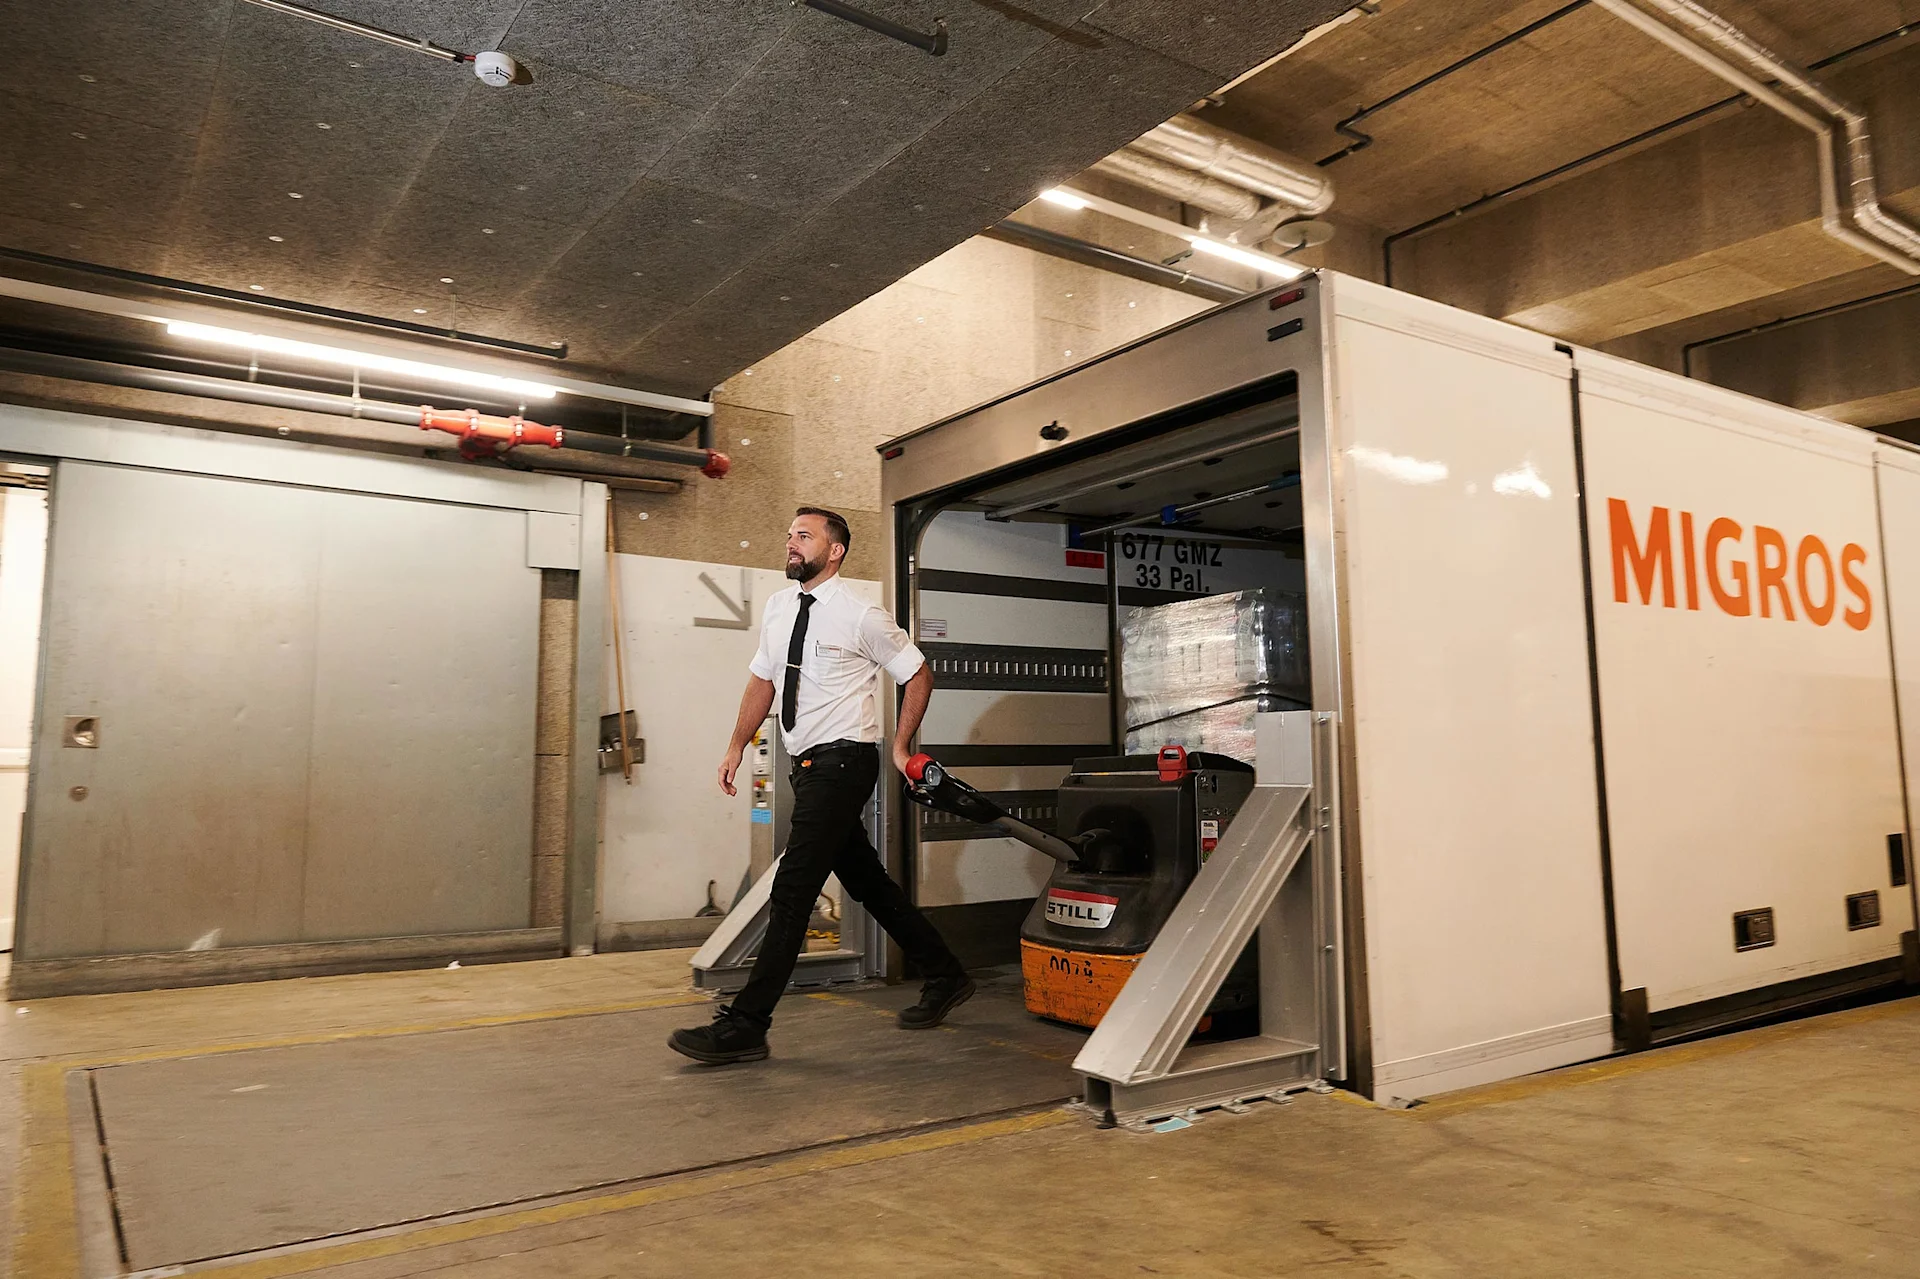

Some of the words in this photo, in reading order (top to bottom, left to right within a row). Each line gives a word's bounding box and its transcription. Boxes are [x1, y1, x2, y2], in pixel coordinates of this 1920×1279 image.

[1122, 533, 1164, 560] 677
[1174, 540, 1222, 566] GMZ
[1607, 497, 1872, 631] MIGROS
[1136, 563, 1161, 588] 33
[1170, 567, 1209, 592] Pal.
[1047, 902, 1100, 920] STILL
